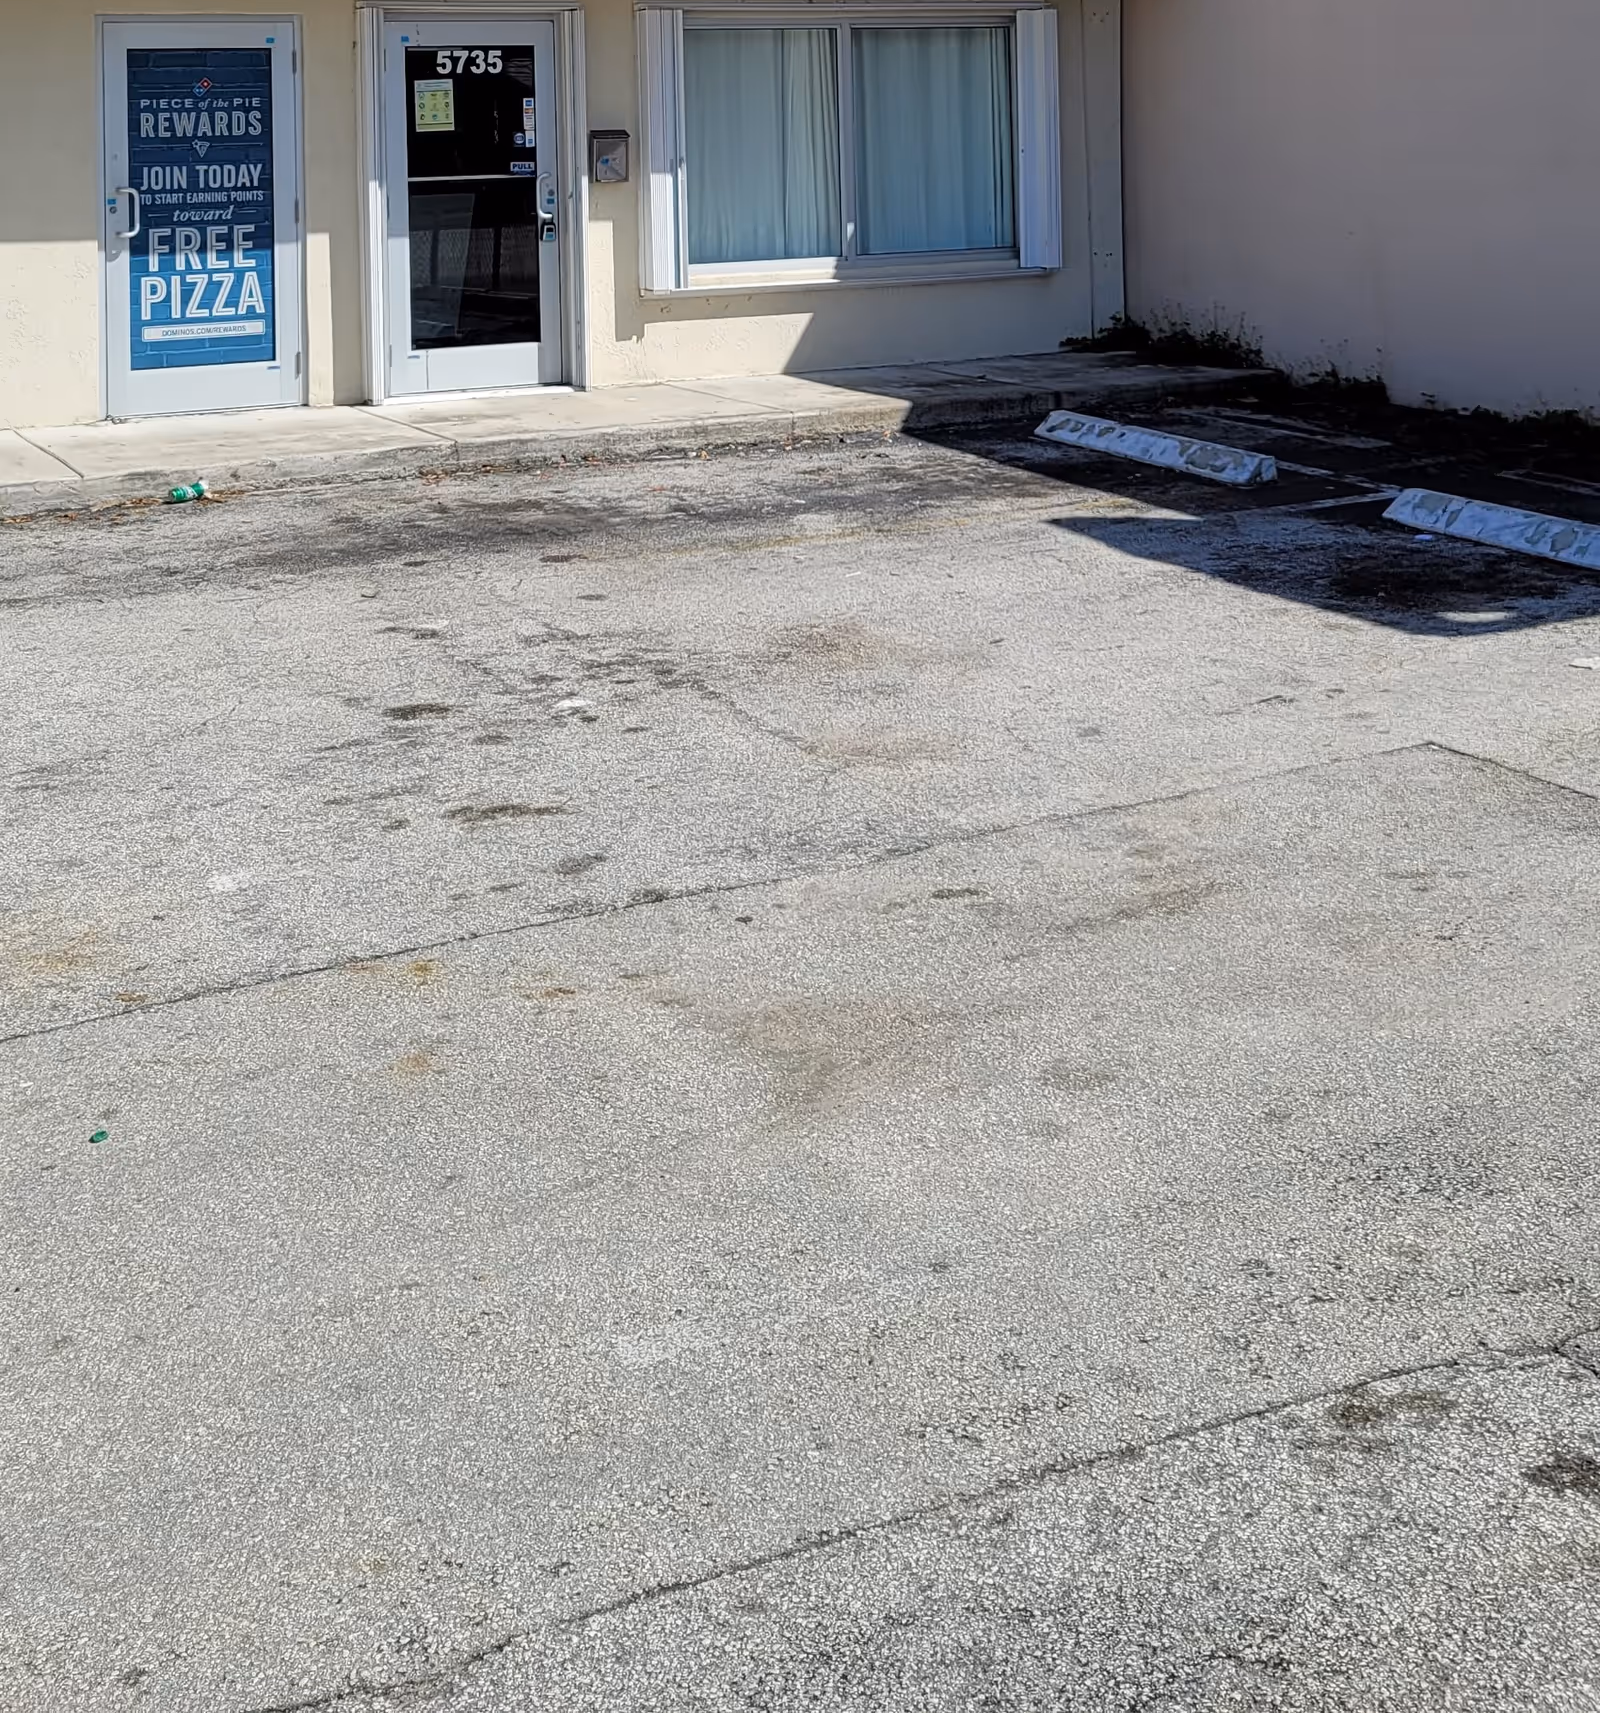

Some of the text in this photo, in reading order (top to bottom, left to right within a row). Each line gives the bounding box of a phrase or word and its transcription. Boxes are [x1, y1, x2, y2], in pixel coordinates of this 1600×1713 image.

[436, 50, 503, 75] 5735
[140, 97, 261, 110] PIECE of the PIE
[140, 110, 262, 138] REWARDS
[140, 163, 263, 191] JOIN TODAY
[140, 190, 264, 206] TO START EARNING POINTS
[172, 204, 235, 222] toward
[148, 224, 257, 272] FREE
[141, 271, 266, 321] PIZZA
[161, 324, 247, 337] DOMINOS.COM/REWARDS
